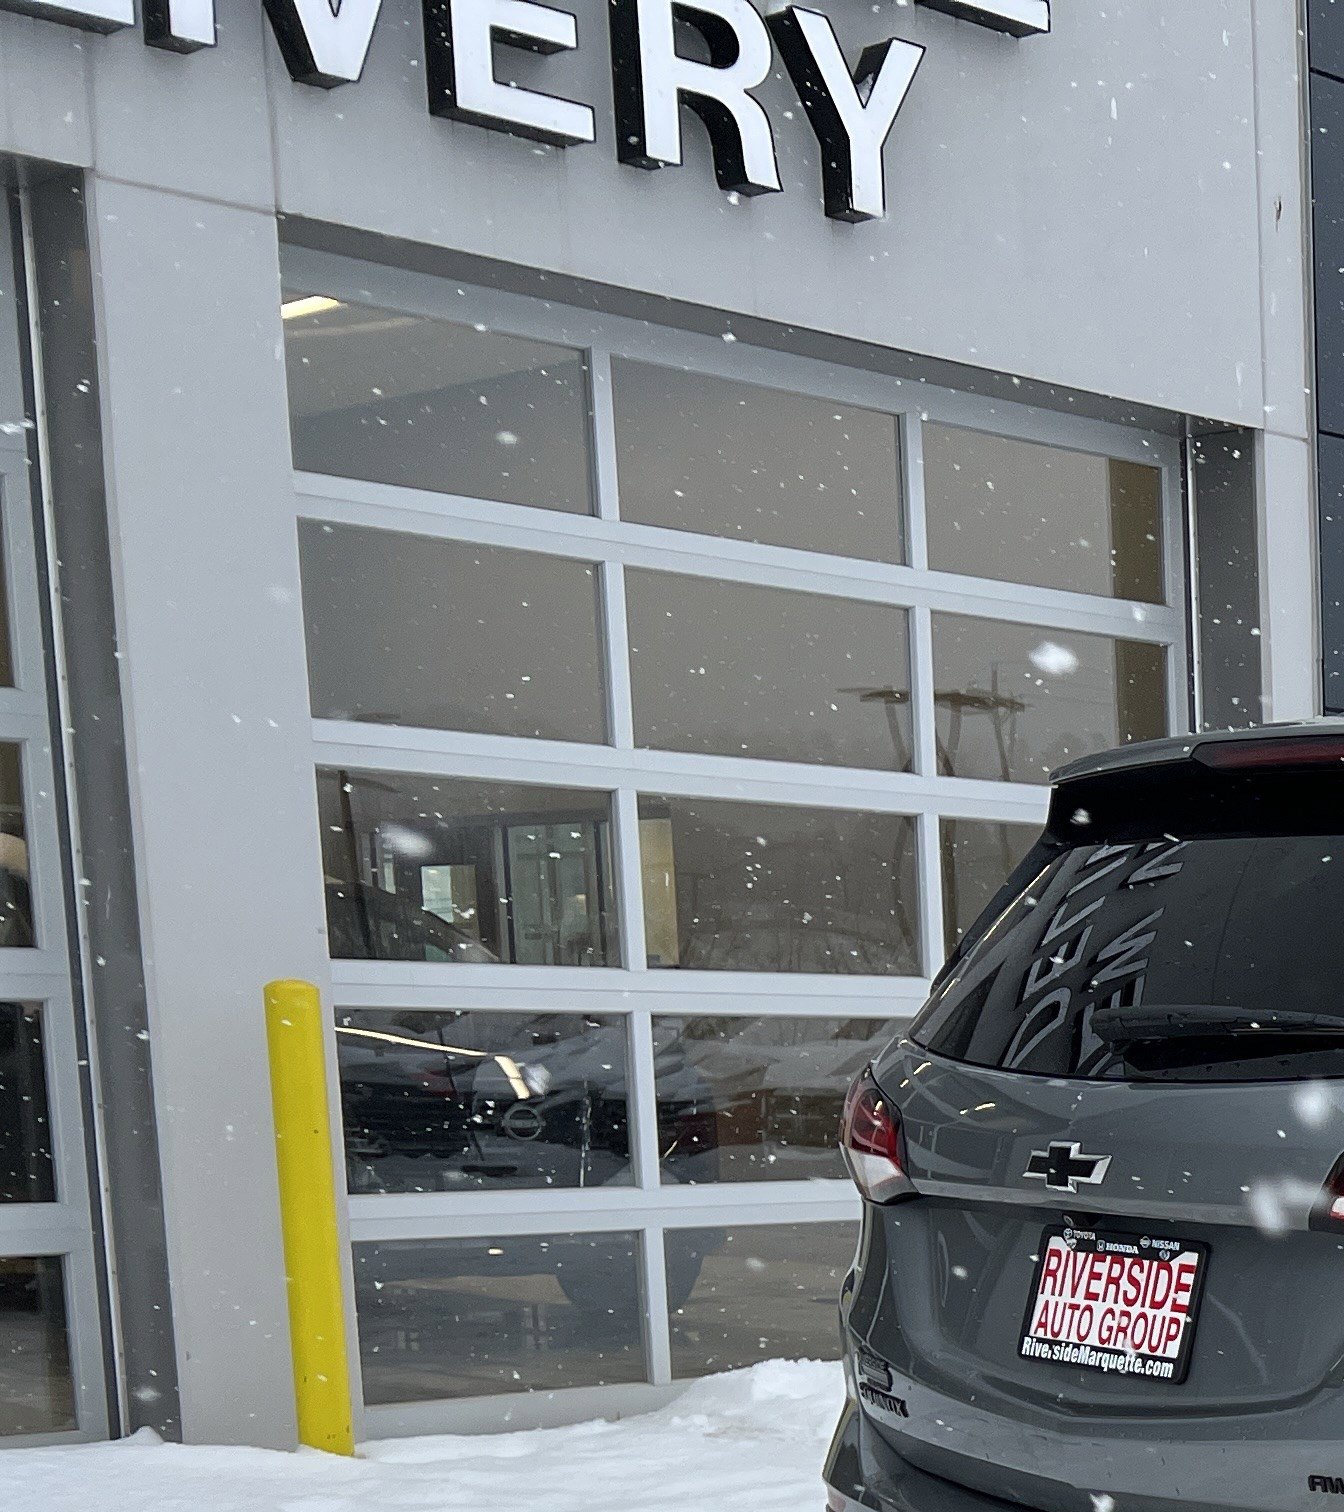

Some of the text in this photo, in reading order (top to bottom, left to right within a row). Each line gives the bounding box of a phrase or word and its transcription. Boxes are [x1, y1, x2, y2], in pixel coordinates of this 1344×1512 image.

[1073, 1230, 1096, 1240] TOYOTA
[1105, 1242, 1139, 1254] HONDA
[1151, 1239, 1181, 1251] NISSAN
[1040, 1248, 1197, 1313] RIVERSIDE
[1034, 1299, 1181, 1354] AUTO GROUP
[1021, 1336, 1175, 1378] RiversideMarquette.com
